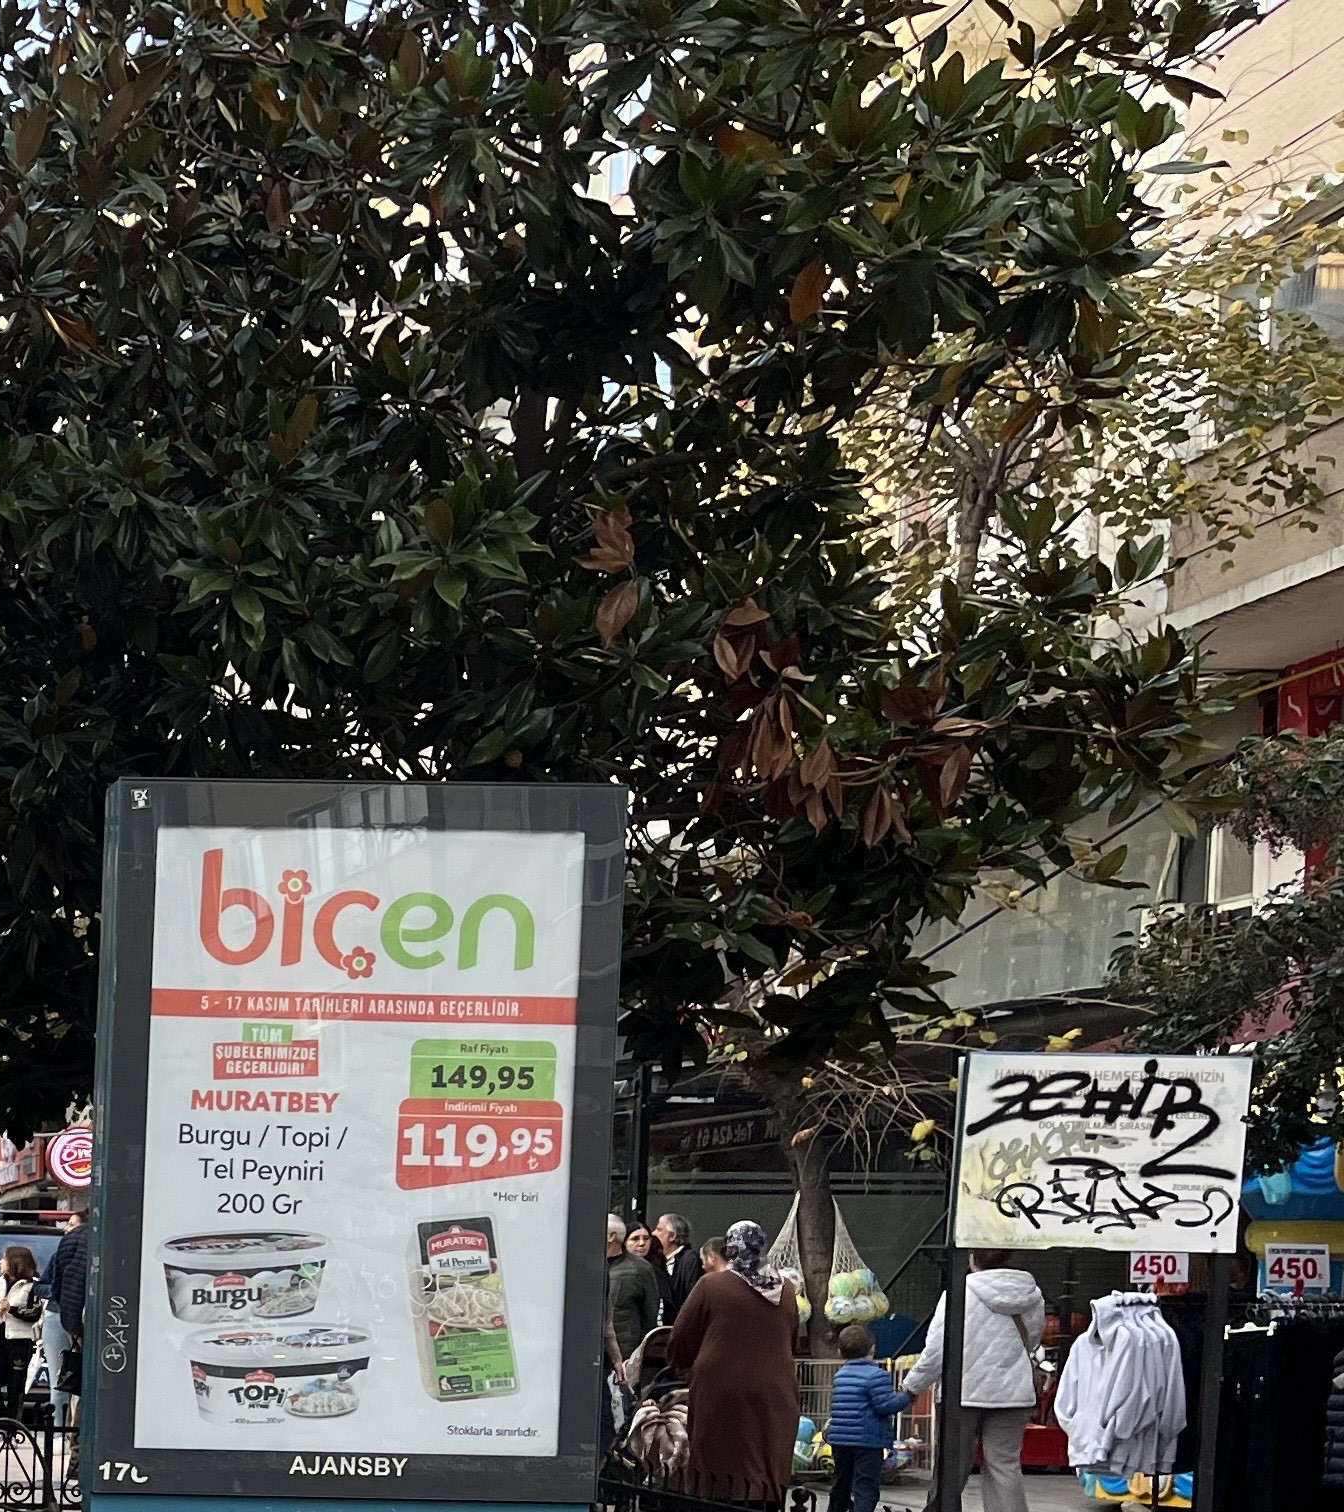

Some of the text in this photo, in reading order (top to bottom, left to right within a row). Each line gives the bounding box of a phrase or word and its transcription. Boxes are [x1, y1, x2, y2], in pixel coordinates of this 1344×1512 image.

[198, 848, 536, 980] biçen
[200, 996, 209, 1010] 5
[226, 996, 243, 1011] 17
[247, 996, 289, 1012] KASIM
[369, 999, 435, 1016] ARASINDA
[251, 1025, 283, 1042] TÜM
[460, 1043, 509, 1055] Raf Fiyatı
[431, 1064, 535, 1096] 149,95
[190, 1089, 341, 1114] MURATBEY
[488, 1102, 518, 1115] Fiyatı
[178, 1123, 348, 1152] Burgu / Topi /
[401, 1123, 554, 1168] 119,95
[198, 1157, 324, 1186] Tel Peyniri
[217, 1192, 303, 1215] 200 Gr
[521, 1192, 539, 1202] biri
[1132, 1254, 1178, 1276] 450
[1268, 1256, 1318, 1280] 450
[191, 1287, 262, 1310] Burgu
[288, 1455, 408, 1478] AJANSBY
